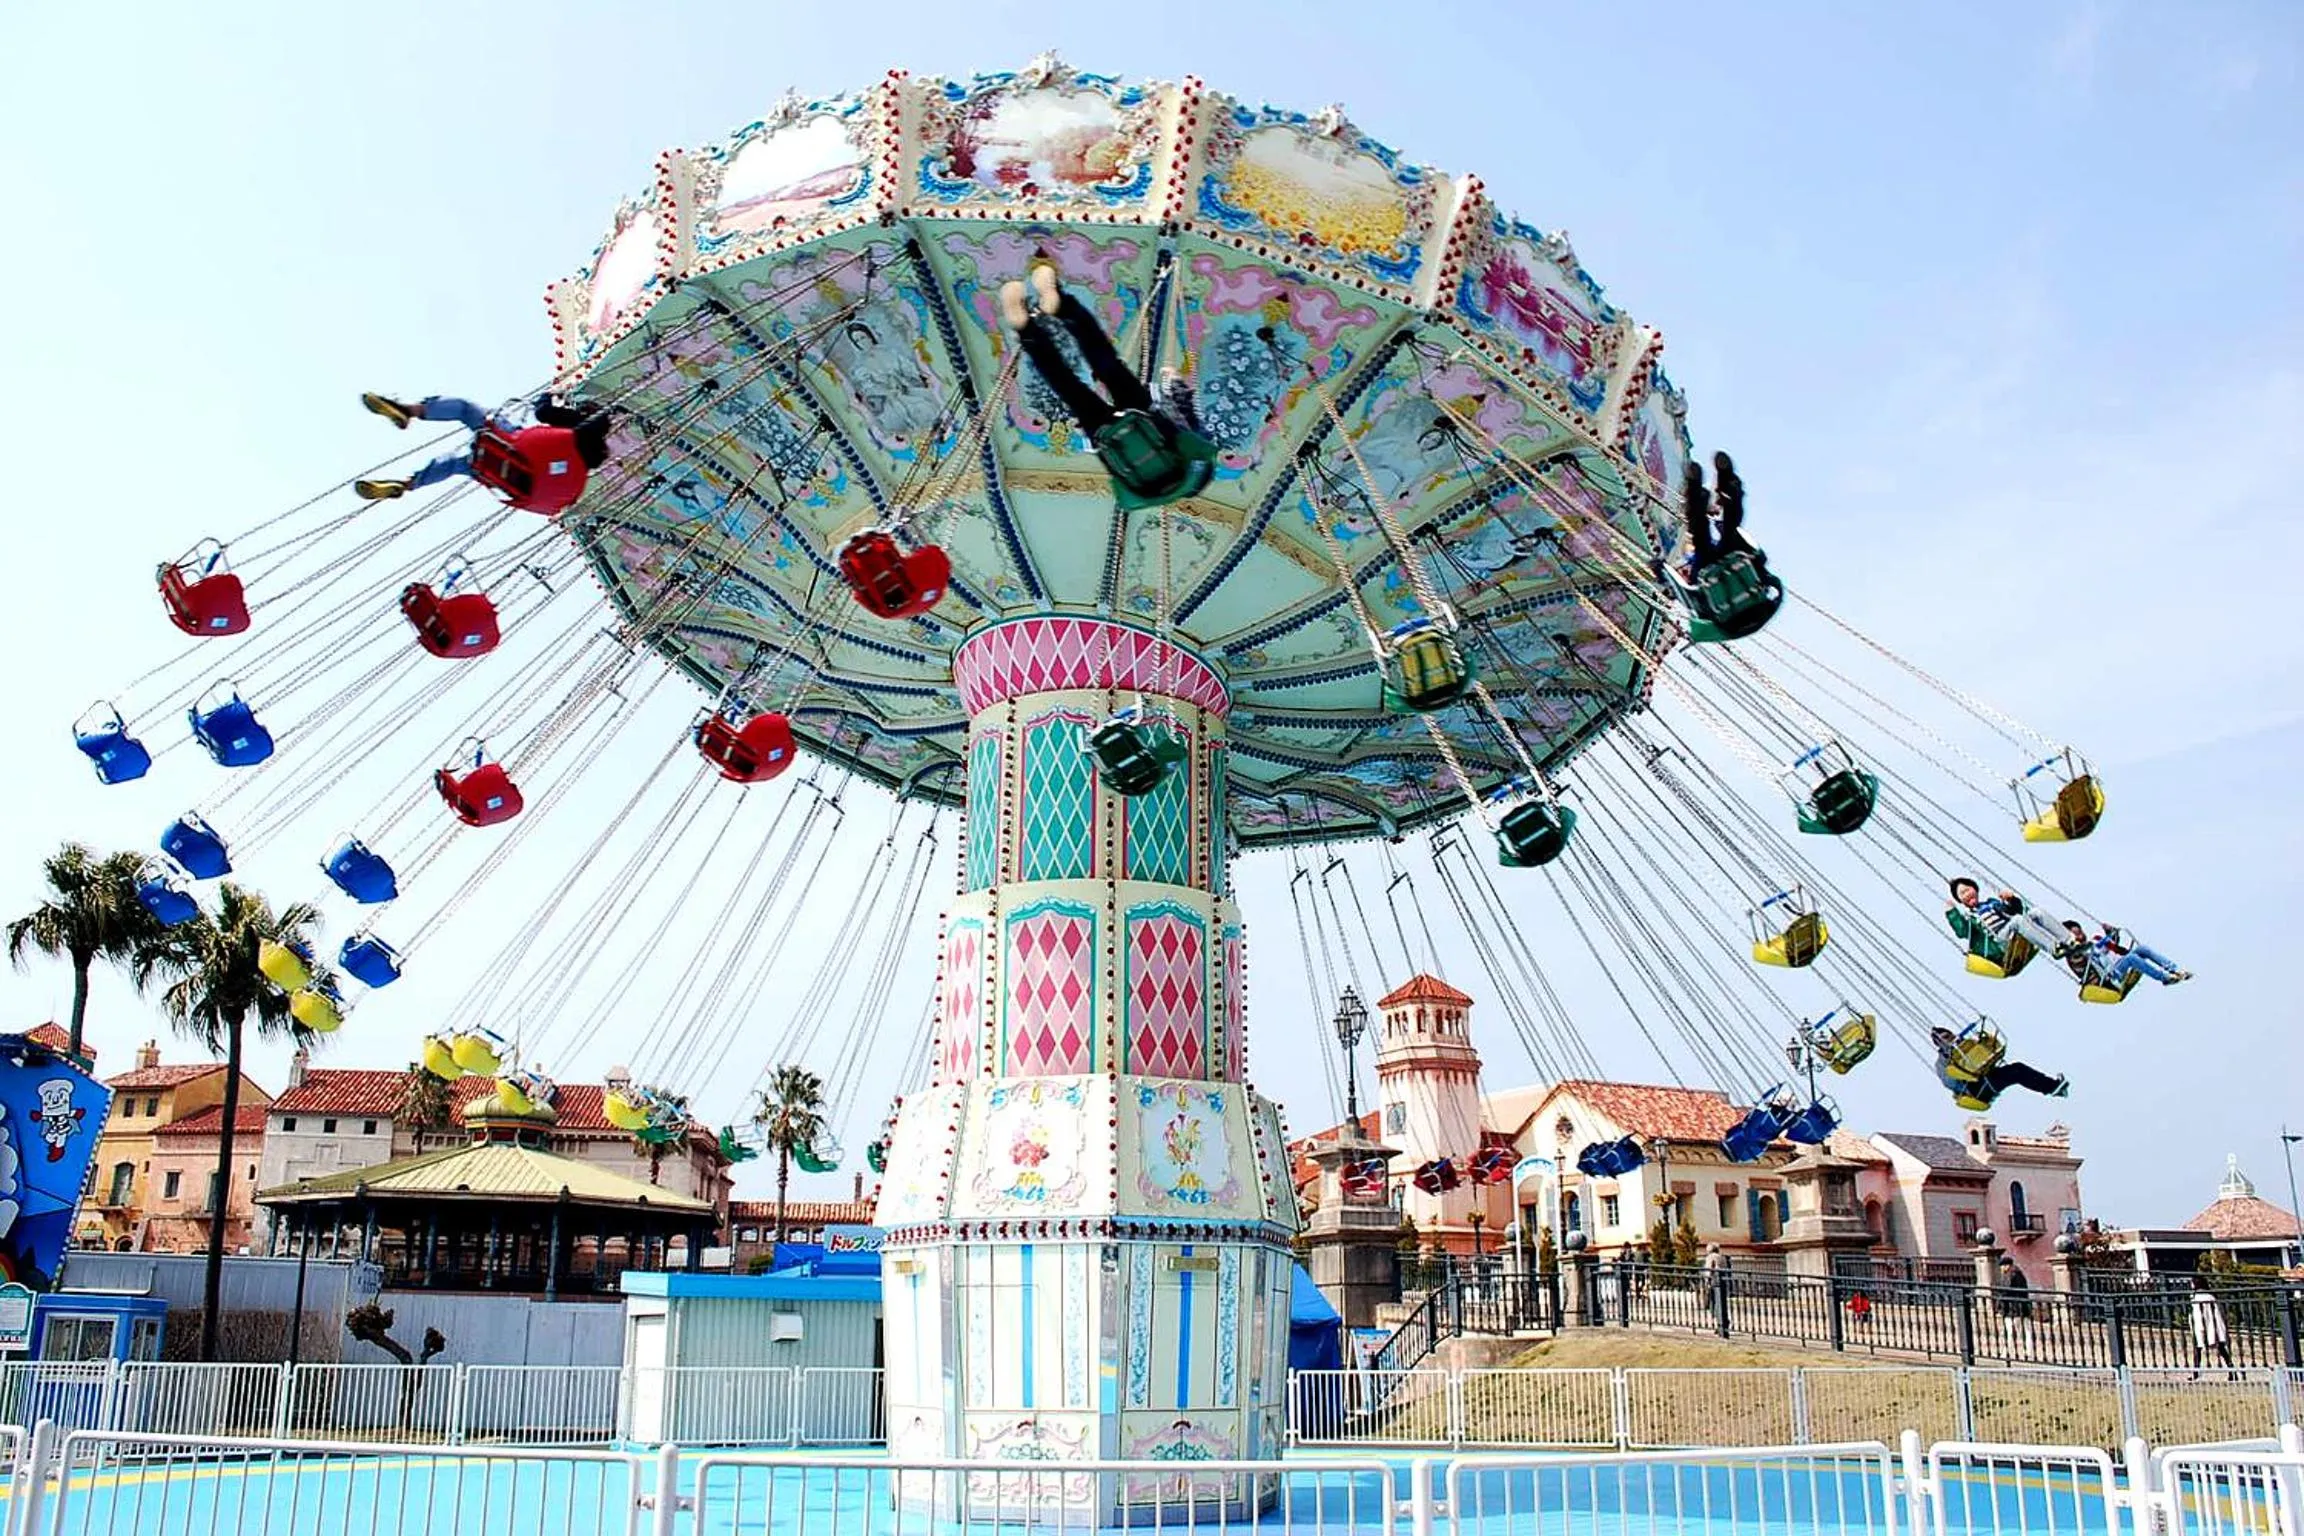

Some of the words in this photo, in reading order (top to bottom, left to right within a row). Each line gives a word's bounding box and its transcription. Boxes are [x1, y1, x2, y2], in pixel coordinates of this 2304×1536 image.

[829, 1233, 881, 1252] ドルフィン
